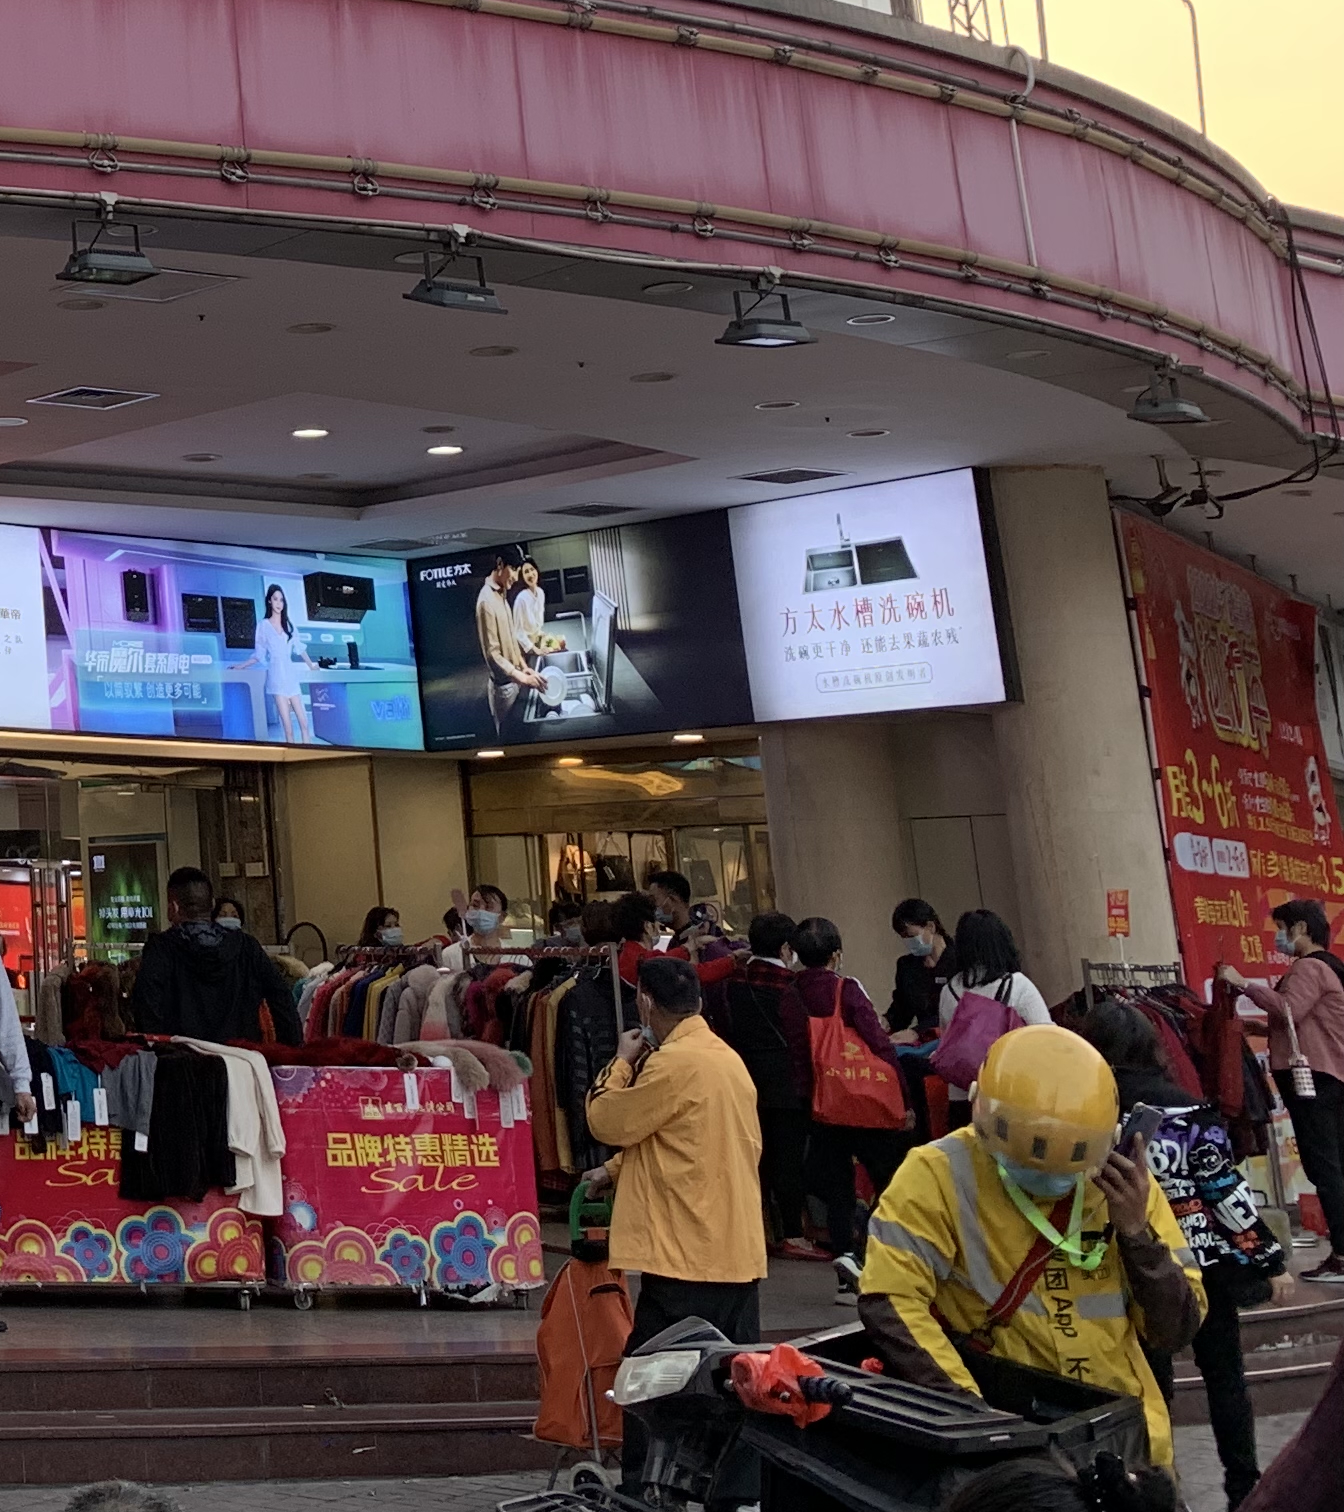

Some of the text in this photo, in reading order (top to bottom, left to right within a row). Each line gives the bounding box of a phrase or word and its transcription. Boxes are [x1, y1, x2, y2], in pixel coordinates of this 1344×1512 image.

[419, 563, 472, 581] FOTILE 方太
[779, 587, 955, 637] 方太水槽洗碗机
[784, 639, 852, 663] 洗碗更干净
[326, 1132, 501, 1167] 品牌特惠精选
[361, 1164, 480, 1194] Sale
